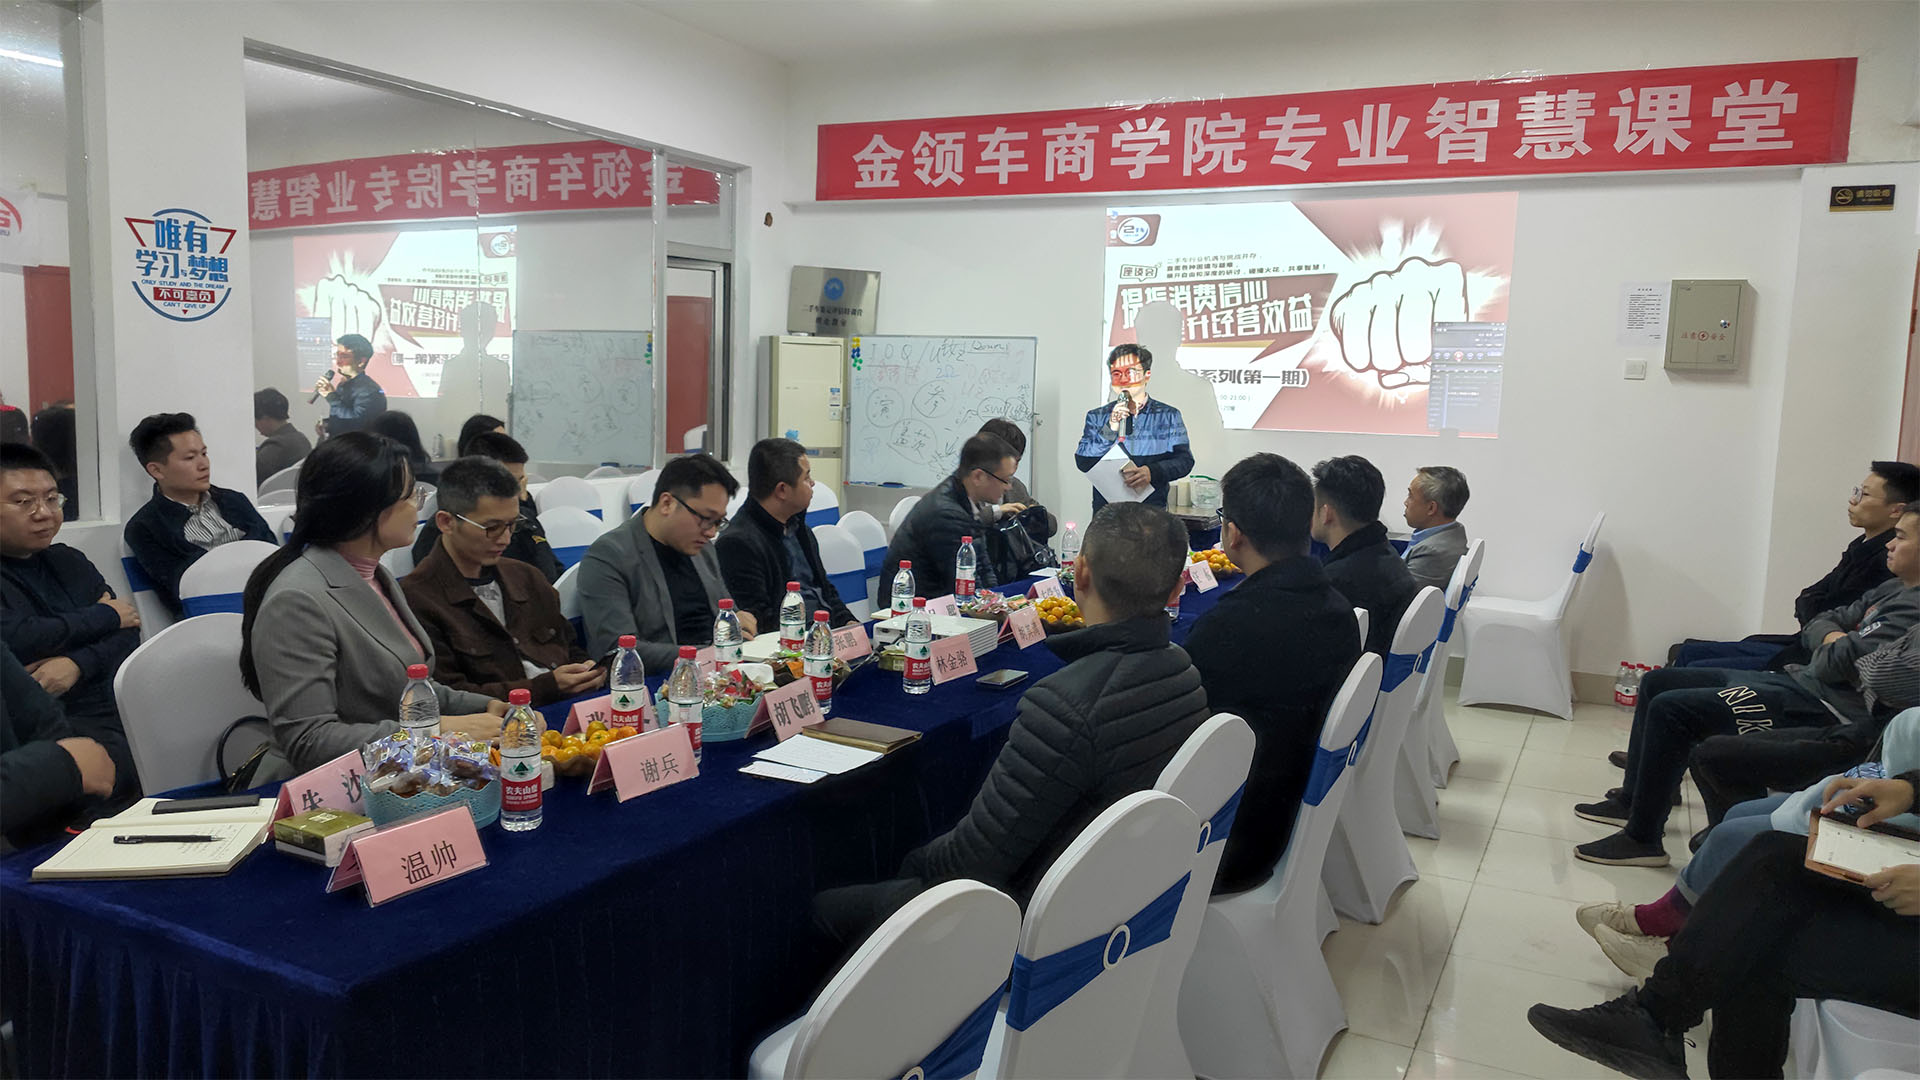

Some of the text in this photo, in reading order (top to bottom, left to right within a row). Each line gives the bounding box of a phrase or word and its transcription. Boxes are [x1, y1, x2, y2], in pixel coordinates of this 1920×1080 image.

[852, 78, 1799, 189] 金领车商学院专业智慧课堂
[154, 218, 209, 254] 唯有
[136, 249, 228, 282] 学习与梦想
[1182, 293, 1313, 341] 升经营效益
[1187, 369, 1308, 385] 系列(第一期)
[773, 690, 816, 727] 胡飞鹏
[640, 752, 680, 784] 谢兵
[400, 840, 457, 885] 温帅
